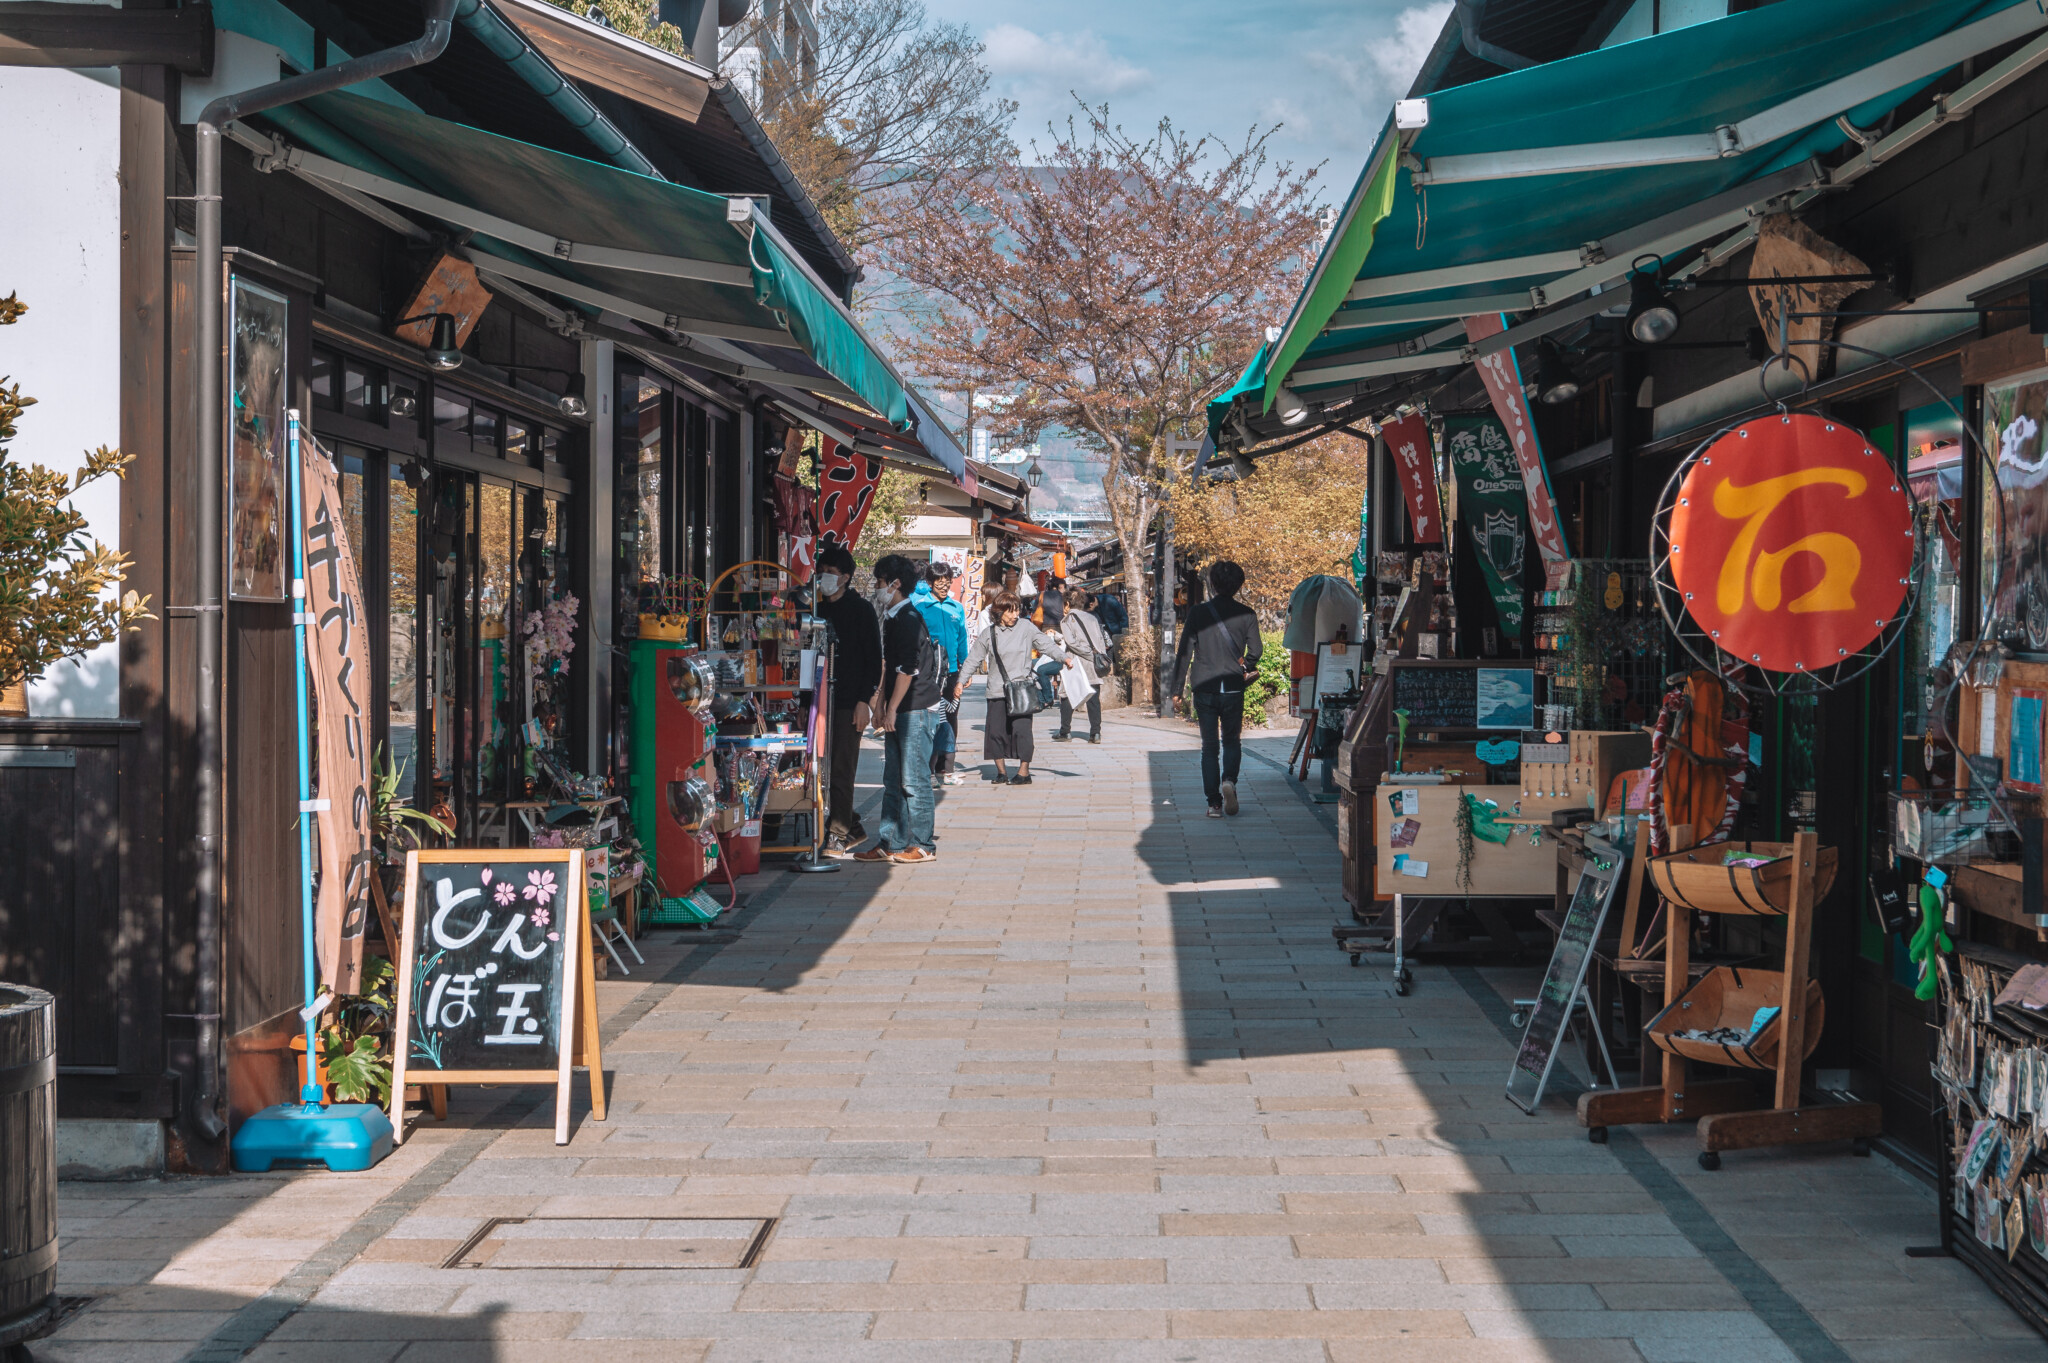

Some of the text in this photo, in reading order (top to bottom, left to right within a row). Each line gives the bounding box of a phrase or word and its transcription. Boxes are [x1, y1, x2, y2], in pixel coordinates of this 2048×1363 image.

[1473, 478, 1523, 494] OneSoul
[966, 559, 983, 621] タピオカ
